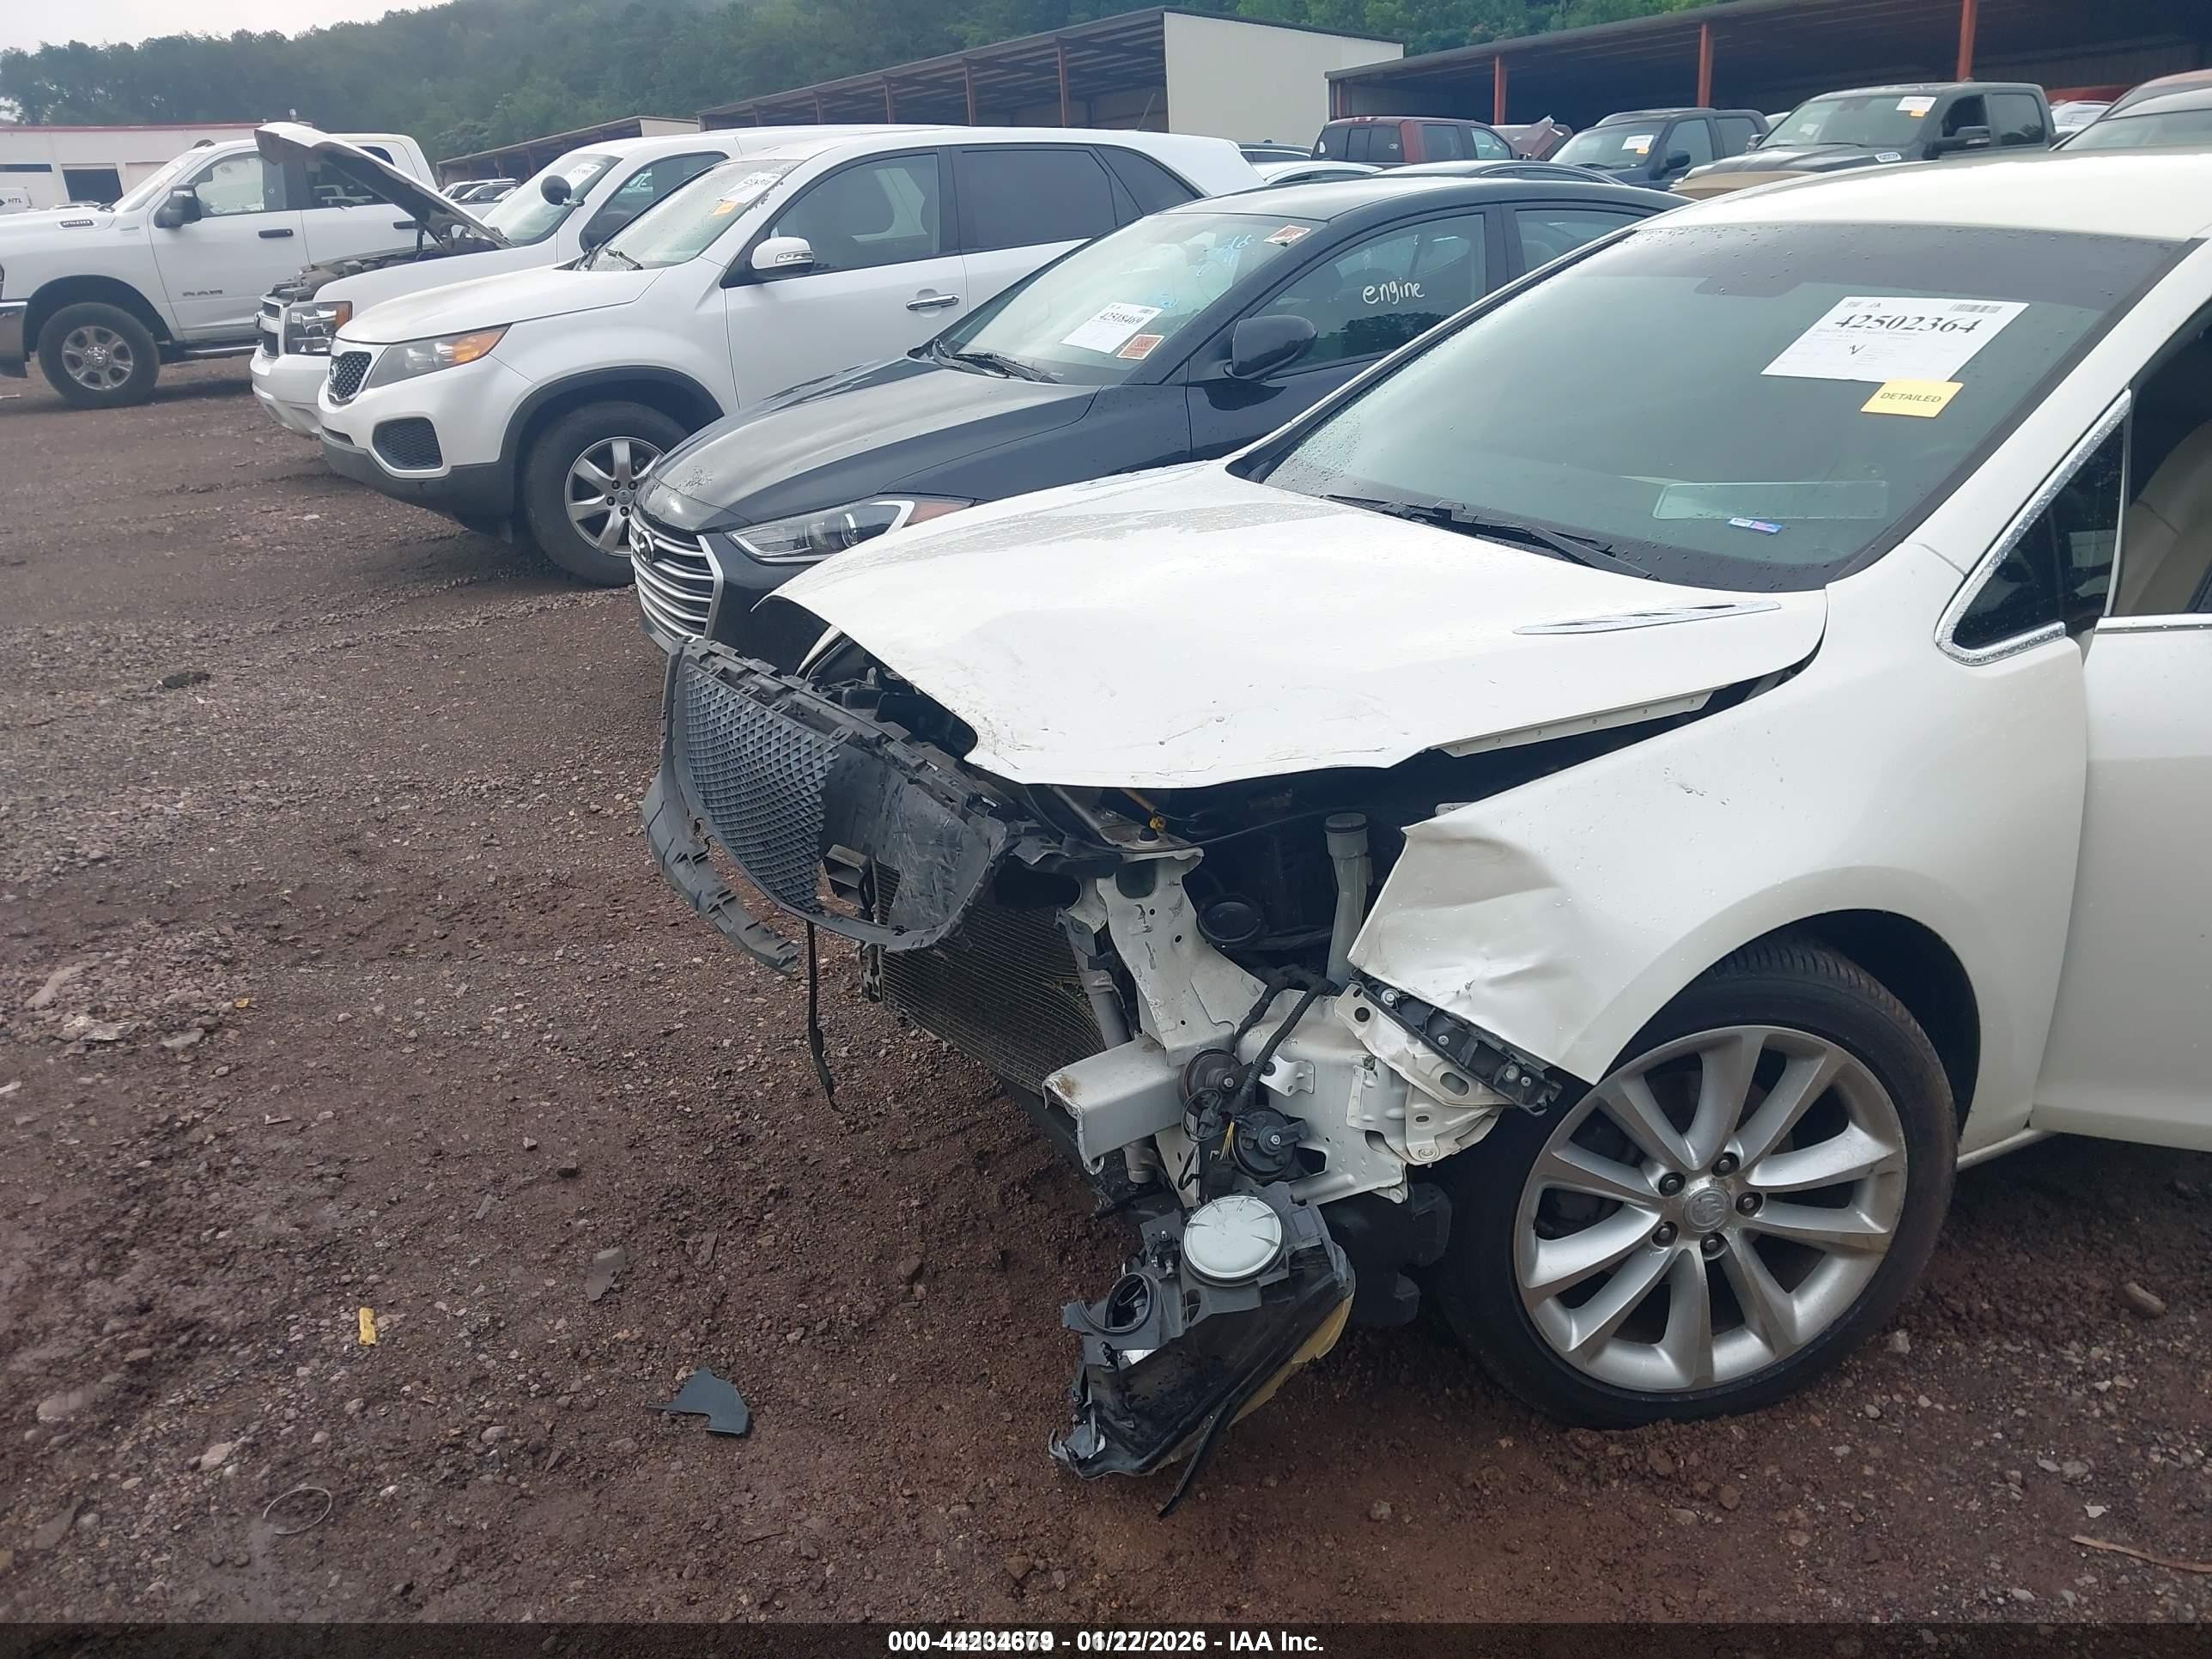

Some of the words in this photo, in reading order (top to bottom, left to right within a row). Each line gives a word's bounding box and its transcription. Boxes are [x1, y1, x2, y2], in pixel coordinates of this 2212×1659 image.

[1362, 276, 1425, 306] engine
[1834, 313, 1983, 334] 42502364
[1880, 392, 1943, 403] DETAILED
